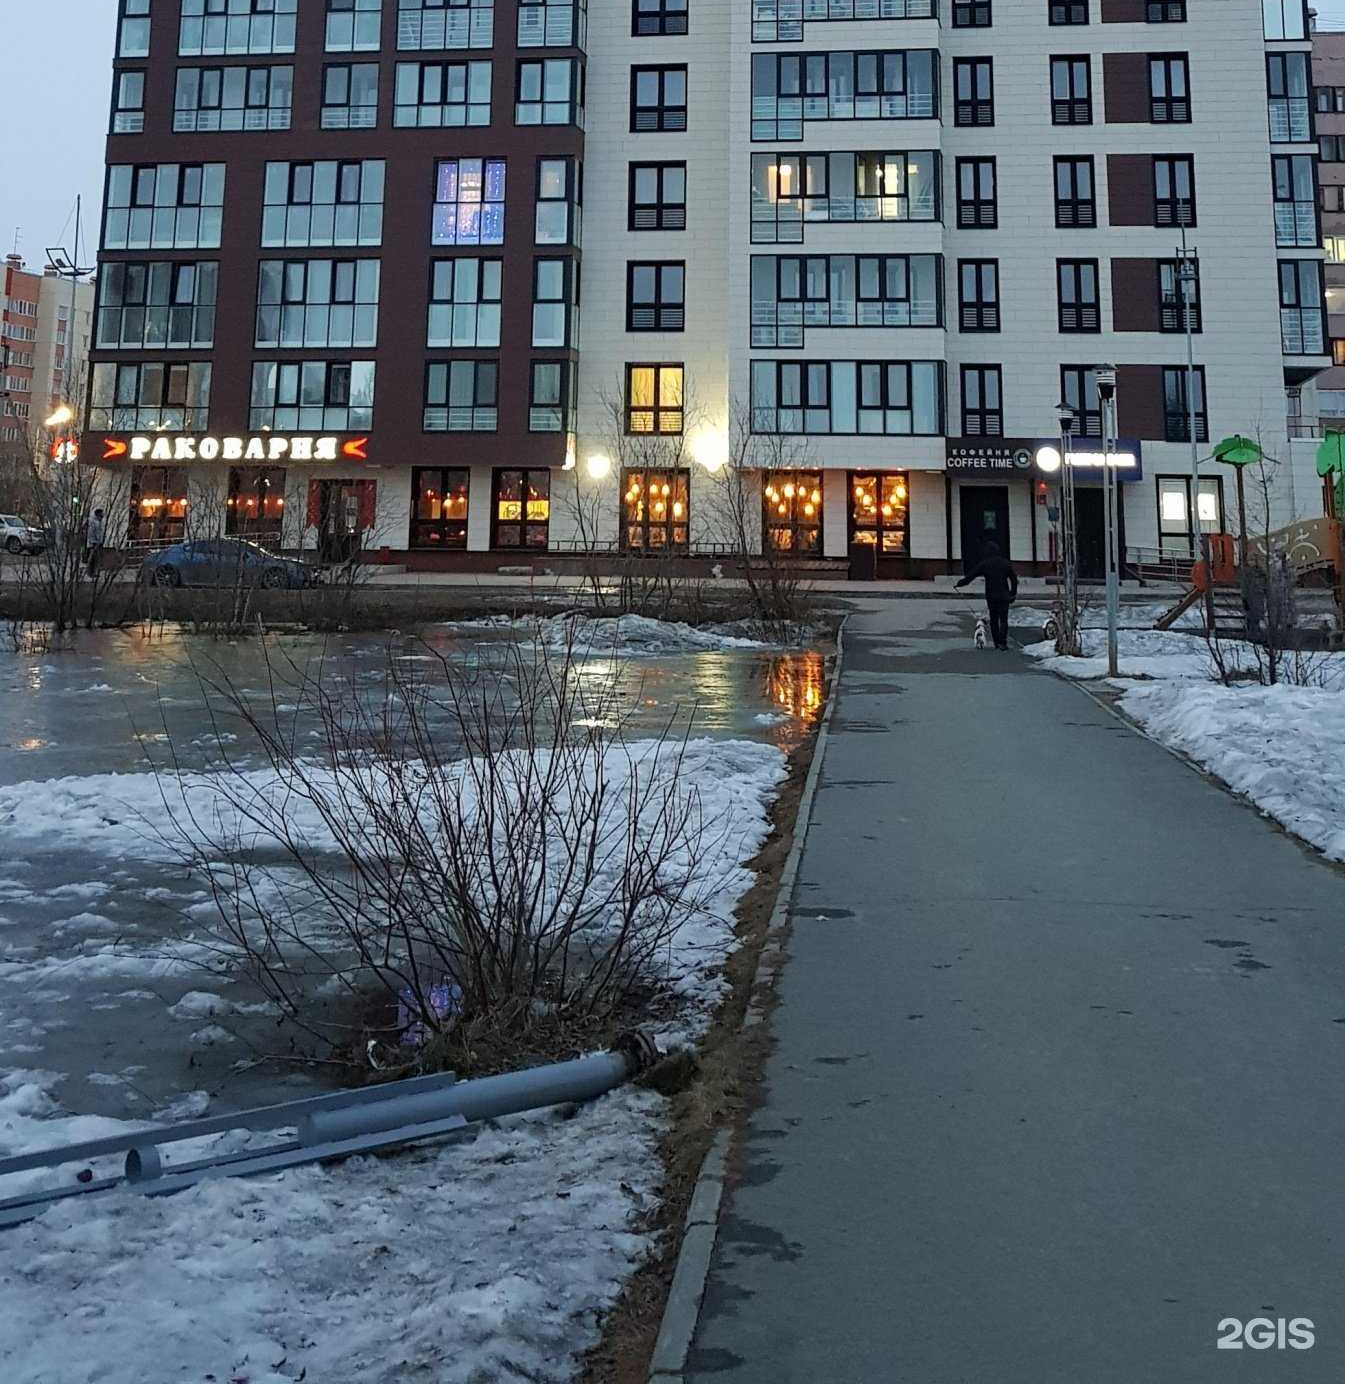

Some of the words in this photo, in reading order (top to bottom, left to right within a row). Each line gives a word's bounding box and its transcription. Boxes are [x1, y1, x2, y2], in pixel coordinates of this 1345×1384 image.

[129, 436, 338, 460] РАКОВАРНЯ
[951, 448, 1010, 456] КОФЕЙНЯ
[947, 457, 987, 468] COFFEE
[989, 457, 1014, 468] TIME
